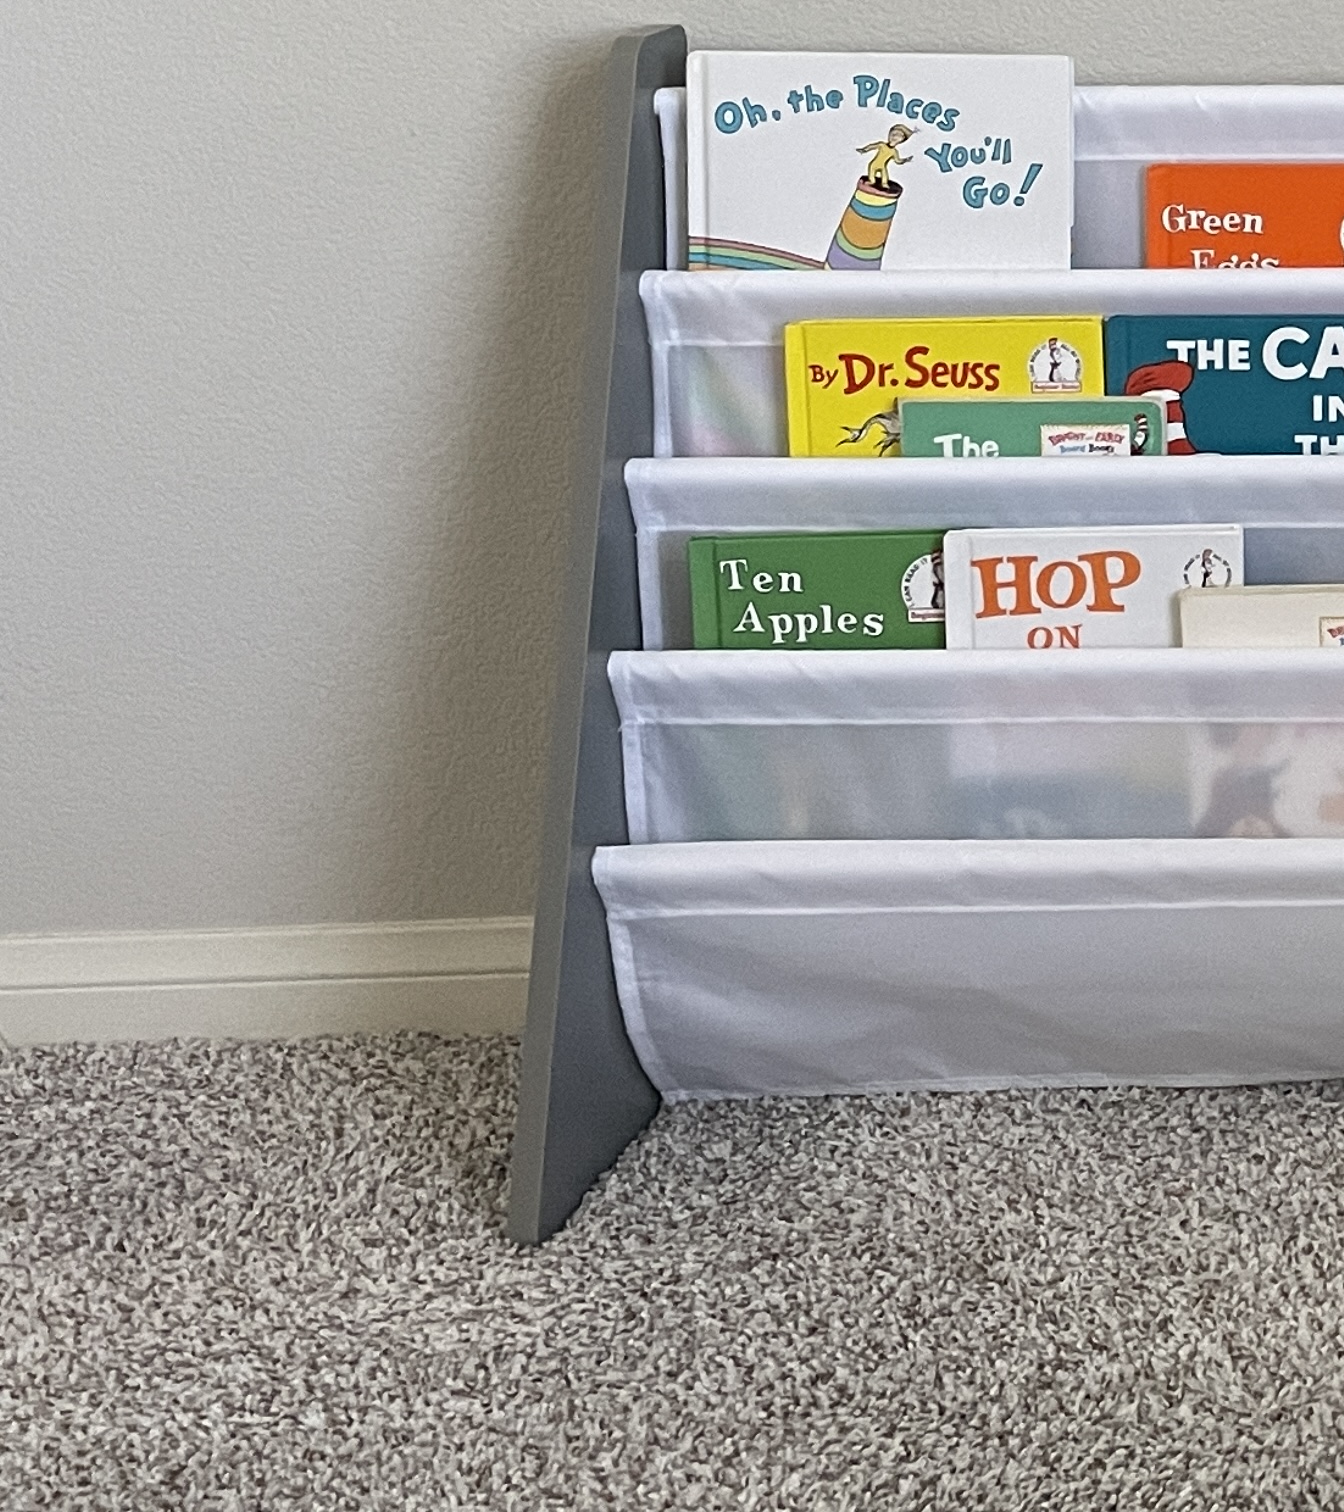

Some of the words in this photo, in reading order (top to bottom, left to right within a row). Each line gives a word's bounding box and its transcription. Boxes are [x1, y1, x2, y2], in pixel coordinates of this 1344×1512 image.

[714, 97, 782, 134] Oh,
[787, 84, 844, 114] the
[852, 75, 961, 132] Places
[923, 136, 1013, 173] You'll
[962, 163, 1044, 209] Go!
[1161, 203, 1264, 235] Green
[808, 364, 839, 389] By
[838, 353, 899, 395] Dr.
[904, 346, 1000, 391] Seuss
[1166, 339, 1251, 372] THE
[933, 433, 999, 458] The
[719, 559, 802, 594] Ten
[969, 549, 1142, 619] HOP
[733, 601, 884, 645] Apples
[1027, 623, 1083, 649] ON
